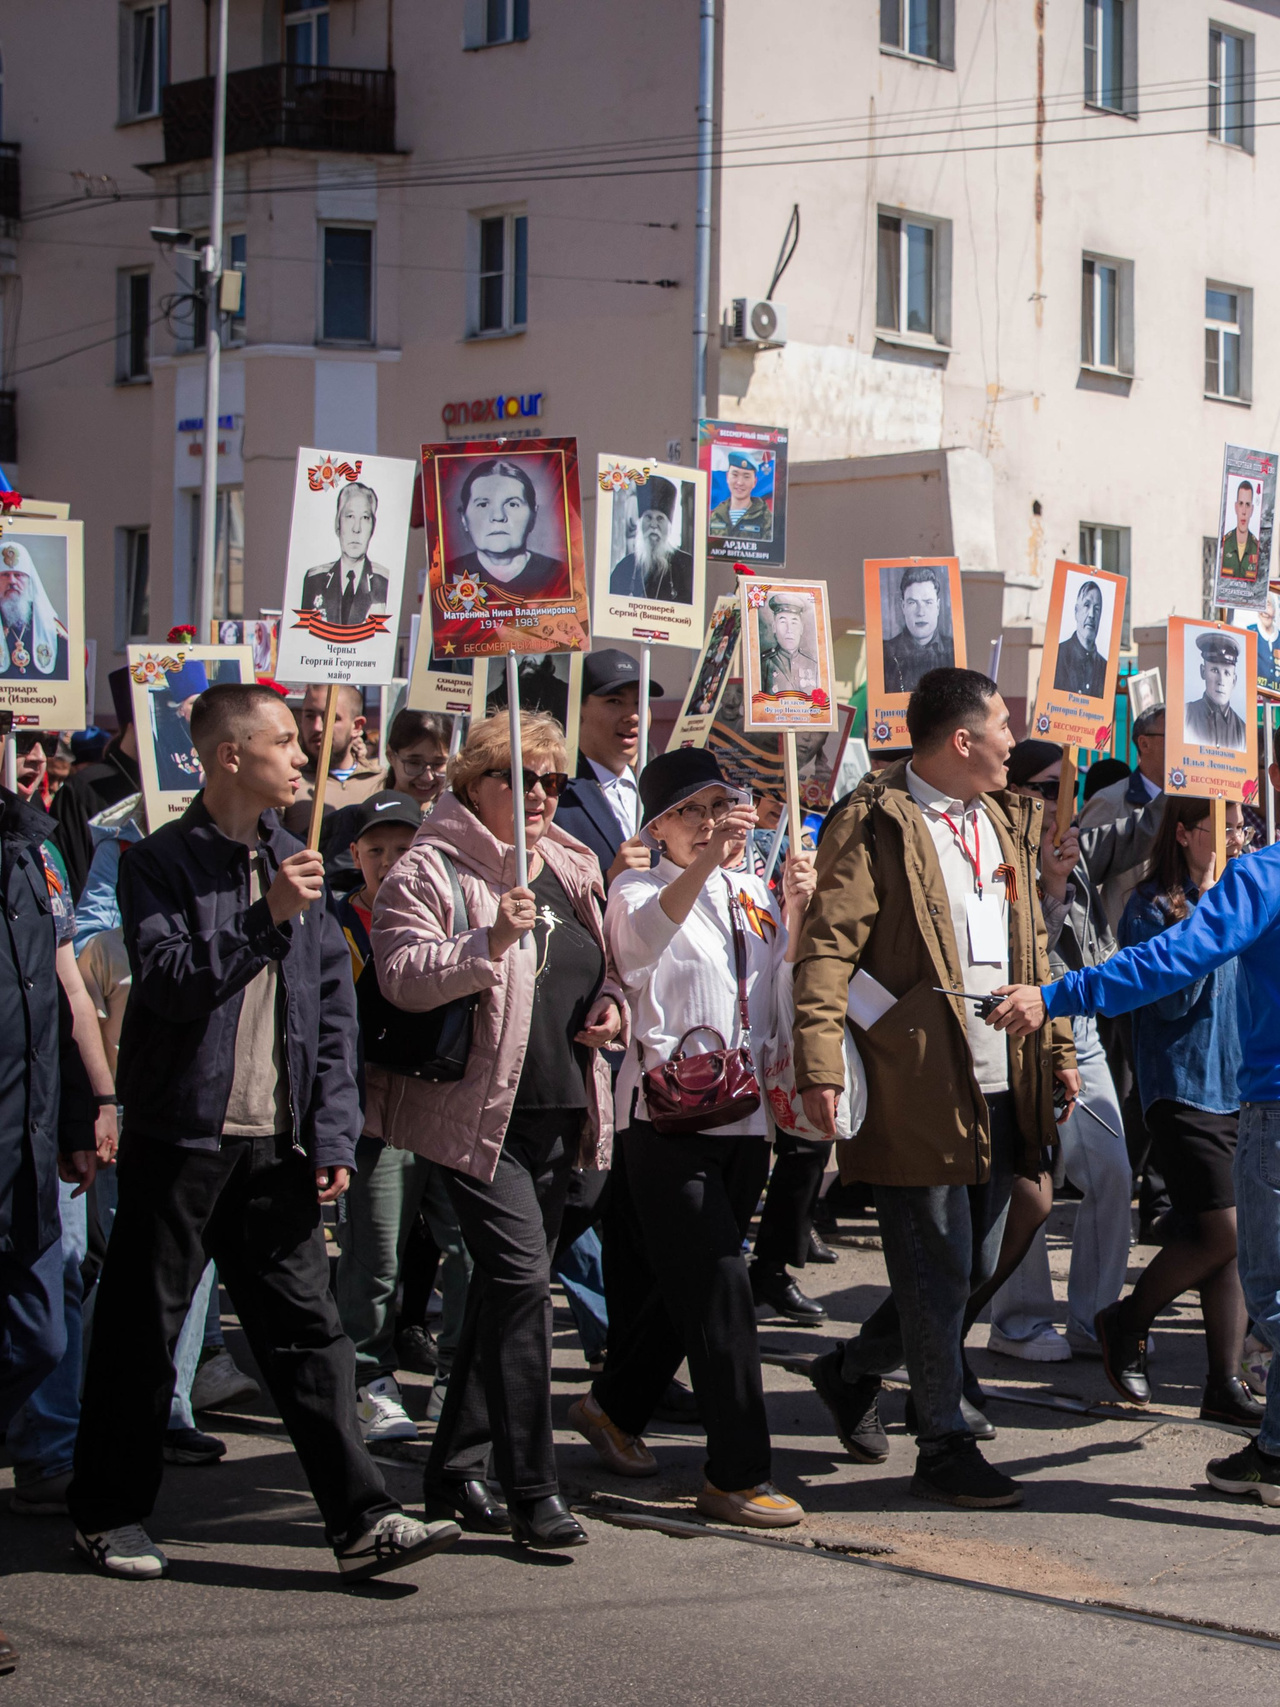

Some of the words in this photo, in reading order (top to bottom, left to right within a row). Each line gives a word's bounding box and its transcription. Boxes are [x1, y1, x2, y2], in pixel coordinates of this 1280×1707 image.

[442, 392, 543, 425] anextour
[723, 541, 757, 551] АРДАЕВ
[491, 608, 514, 618] Нина
[515, 606, 577, 617] Владимировна
[628, 602, 675, 614] протоиерей
[480, 619, 504, 629] 1917
[515, 617, 540, 627] 1983
[609, 607, 638, 618] Сергий
[639, 612, 692, 627] (Вишневский)
[326, 644, 357, 656] Черных
[463, 639, 532, 653] БЕССМЕРТНЫЙ
[300, 656, 333, 668] Георгий
[335, 657, 376, 669] Георгиевич
[327, 671, 351, 681] майор
[0, 686, 38, 695] атриарх
[435, 684, 466, 695] Михаил
[8, 694, 57, 706] (Извеков)
[875, 708, 907, 719] Григор
[1046, 702, 1078, 716] Григорий
[1053, 721, 1095, 736] БЕССМЕРТНЫЙ
[1182, 756, 1205, 767] Илья
[1190, 775, 1242, 789] БЕССМЕРТНЫЙ
[1208, 787, 1228, 797] ПОЛК
